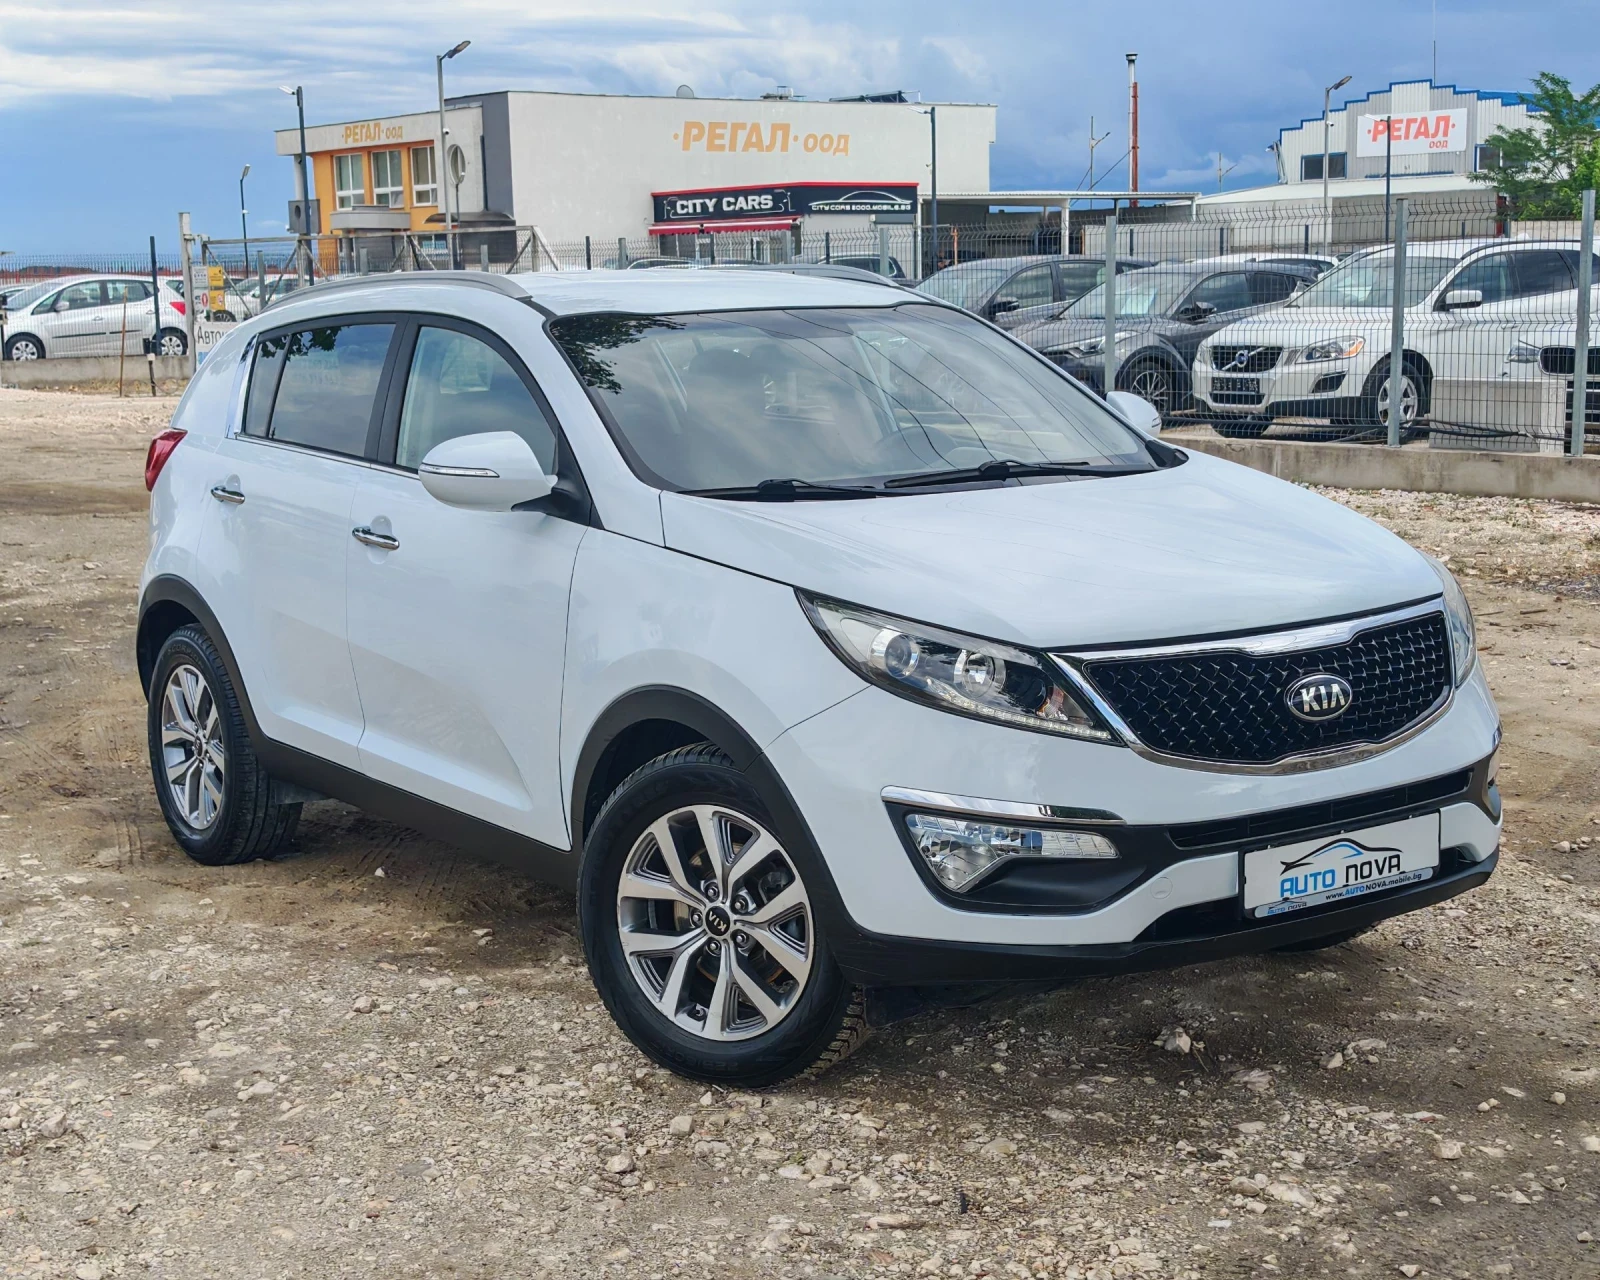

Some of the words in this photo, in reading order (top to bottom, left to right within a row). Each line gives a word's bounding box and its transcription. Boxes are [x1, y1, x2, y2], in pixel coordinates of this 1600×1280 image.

[682, 121, 790, 152] РЕГАЛ
[1371, 116, 1451, 142] РЕГАЛ
[676, 198, 717, 215] CITY
[722, 194, 773, 211] CARS
[1300, 683, 1346, 713] KIA
[1280, 868, 1336, 898] AUTO
[708, 910, 727, 932] KIA
